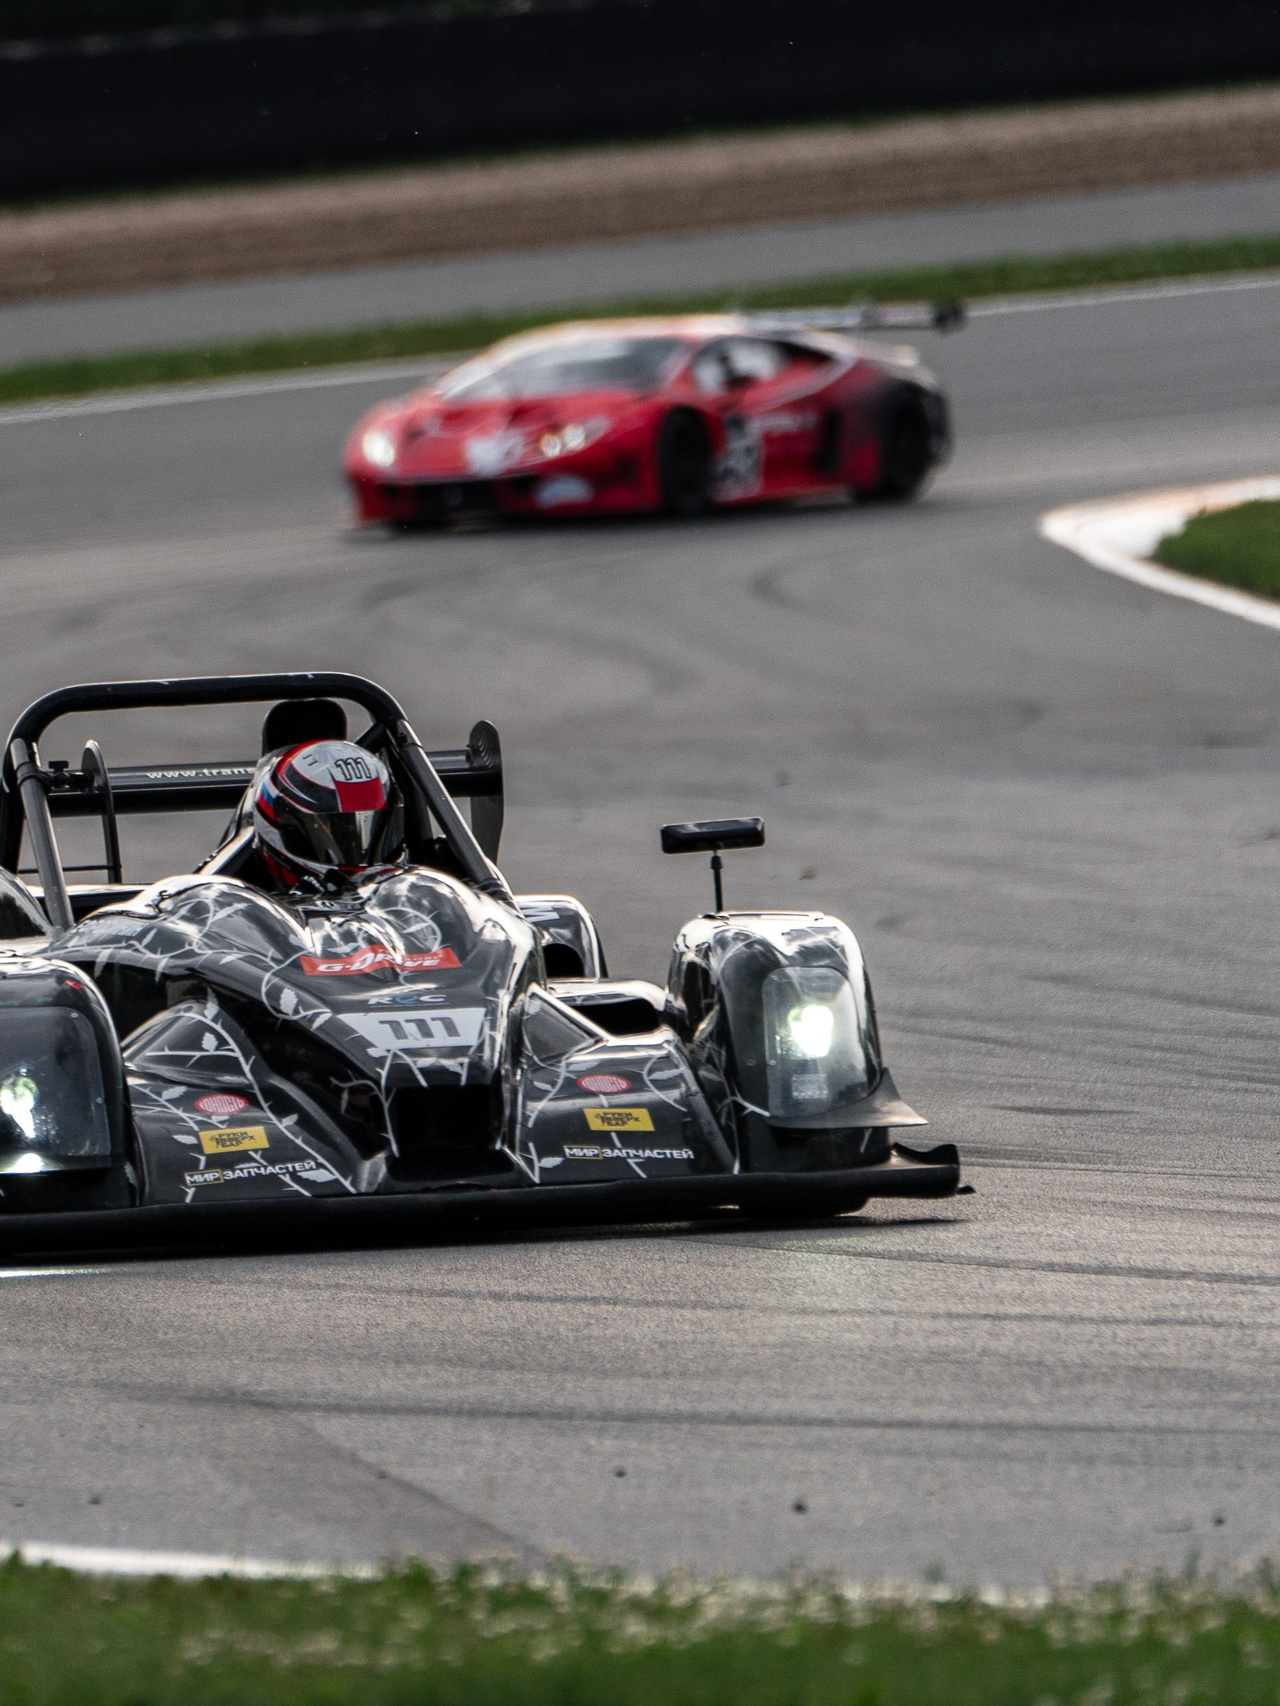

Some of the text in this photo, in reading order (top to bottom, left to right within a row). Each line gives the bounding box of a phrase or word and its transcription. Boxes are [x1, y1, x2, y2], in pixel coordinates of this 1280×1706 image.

[334, 756, 372, 781] 111
[316, 952, 441, 972] G-DRVE
[378, 1017, 460, 1040] 111
[565, 1148, 694, 1159] МИР ЗАПЧАСТЕЙ
[185, 1161, 316, 1185] МИР ЗАПЧАСТЕЙ
